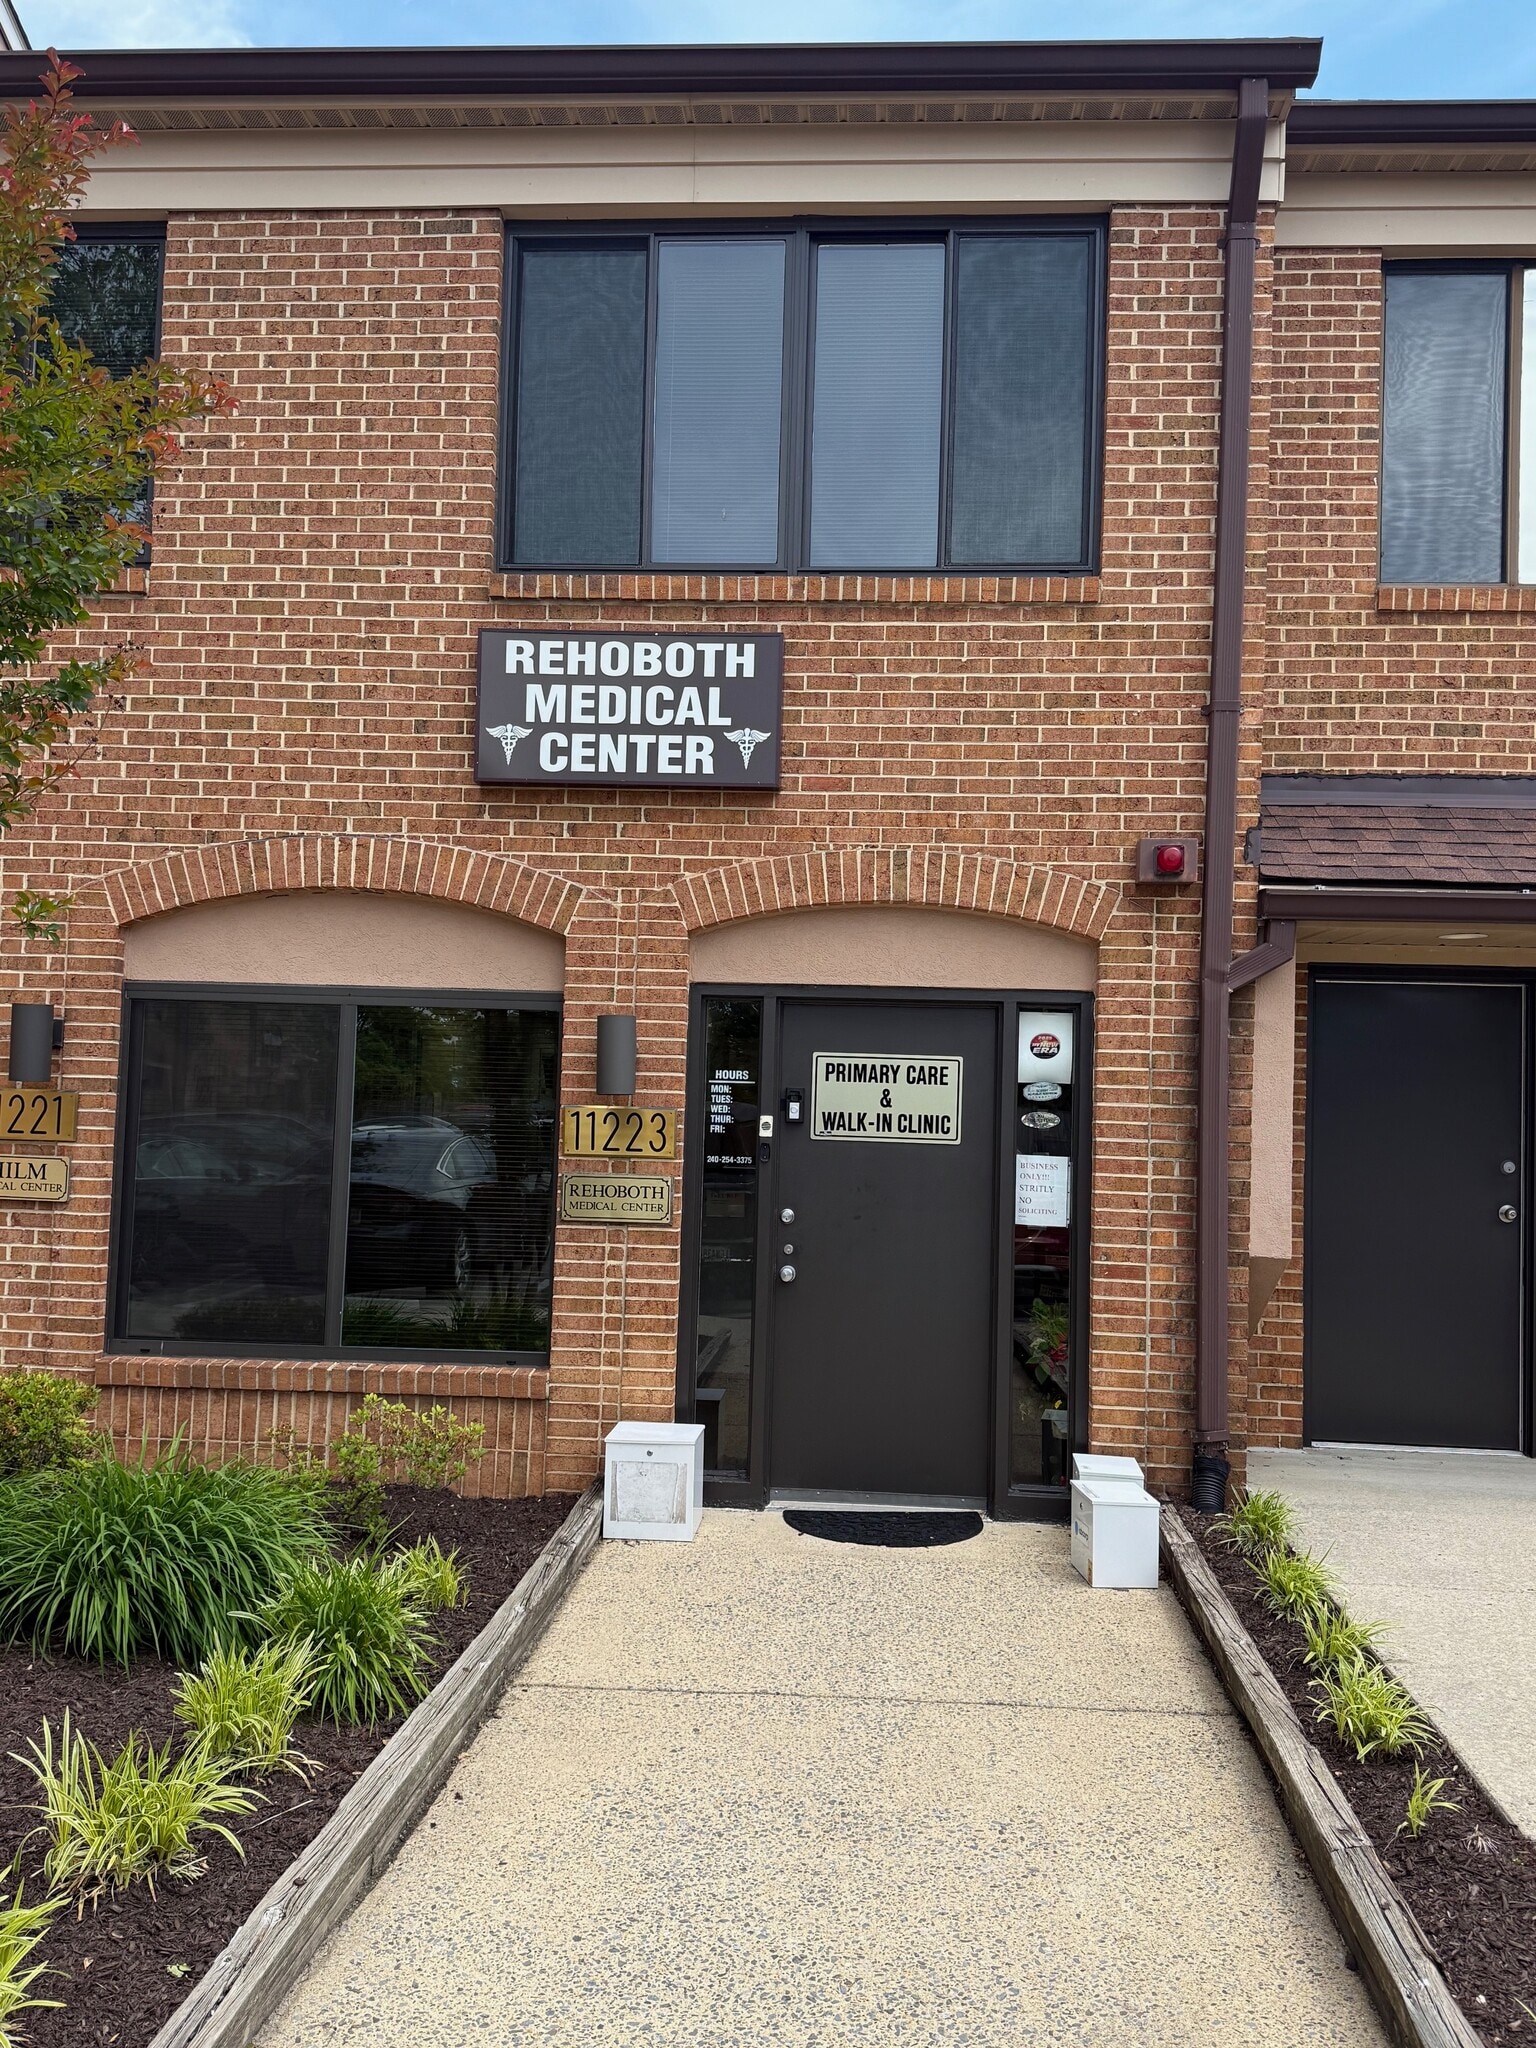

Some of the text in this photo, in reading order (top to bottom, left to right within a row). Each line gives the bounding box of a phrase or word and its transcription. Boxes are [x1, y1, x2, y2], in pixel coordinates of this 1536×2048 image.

[505, 639, 756, 678] REHOBOTH
[525, 683, 732, 727] MEDICAL
[539, 731, 715, 775] CENTER
[715, 1069, 750, 1080] HOURS
[825, 1062, 949, 1086] PRIMARY CARE
[710, 1084, 732, 1094] MON:
[710, 1094, 733, 1104] TUES:
[879, 1088, 893, 1108] &
[0, 1094, 62, 1135] 221
[710, 1104, 731, 1114] WED:
[710, 1114, 734, 1124] THUR:
[822, 1111, 951, 1135] WALK-IN CLINIC
[570, 1110, 667, 1153] 11223
[709, 1124, 726, 1134] FRI:
[706, 1155, 753, 1164] 240-254-3375
[1020, 1162, 1059, 1171] BUSINESS
[1019, 1172, 1050, 1181] ONLY!!!
[20, 1182, 63, 1193] CENTER
[569, 1183, 665, 1200] REHOBOTH
[1018, 1196, 1032, 1205] NO
[569, 1201, 664, 1213] MEDICAL CENTER
[1018, 1207, 1058, 1215] SOLICITING
